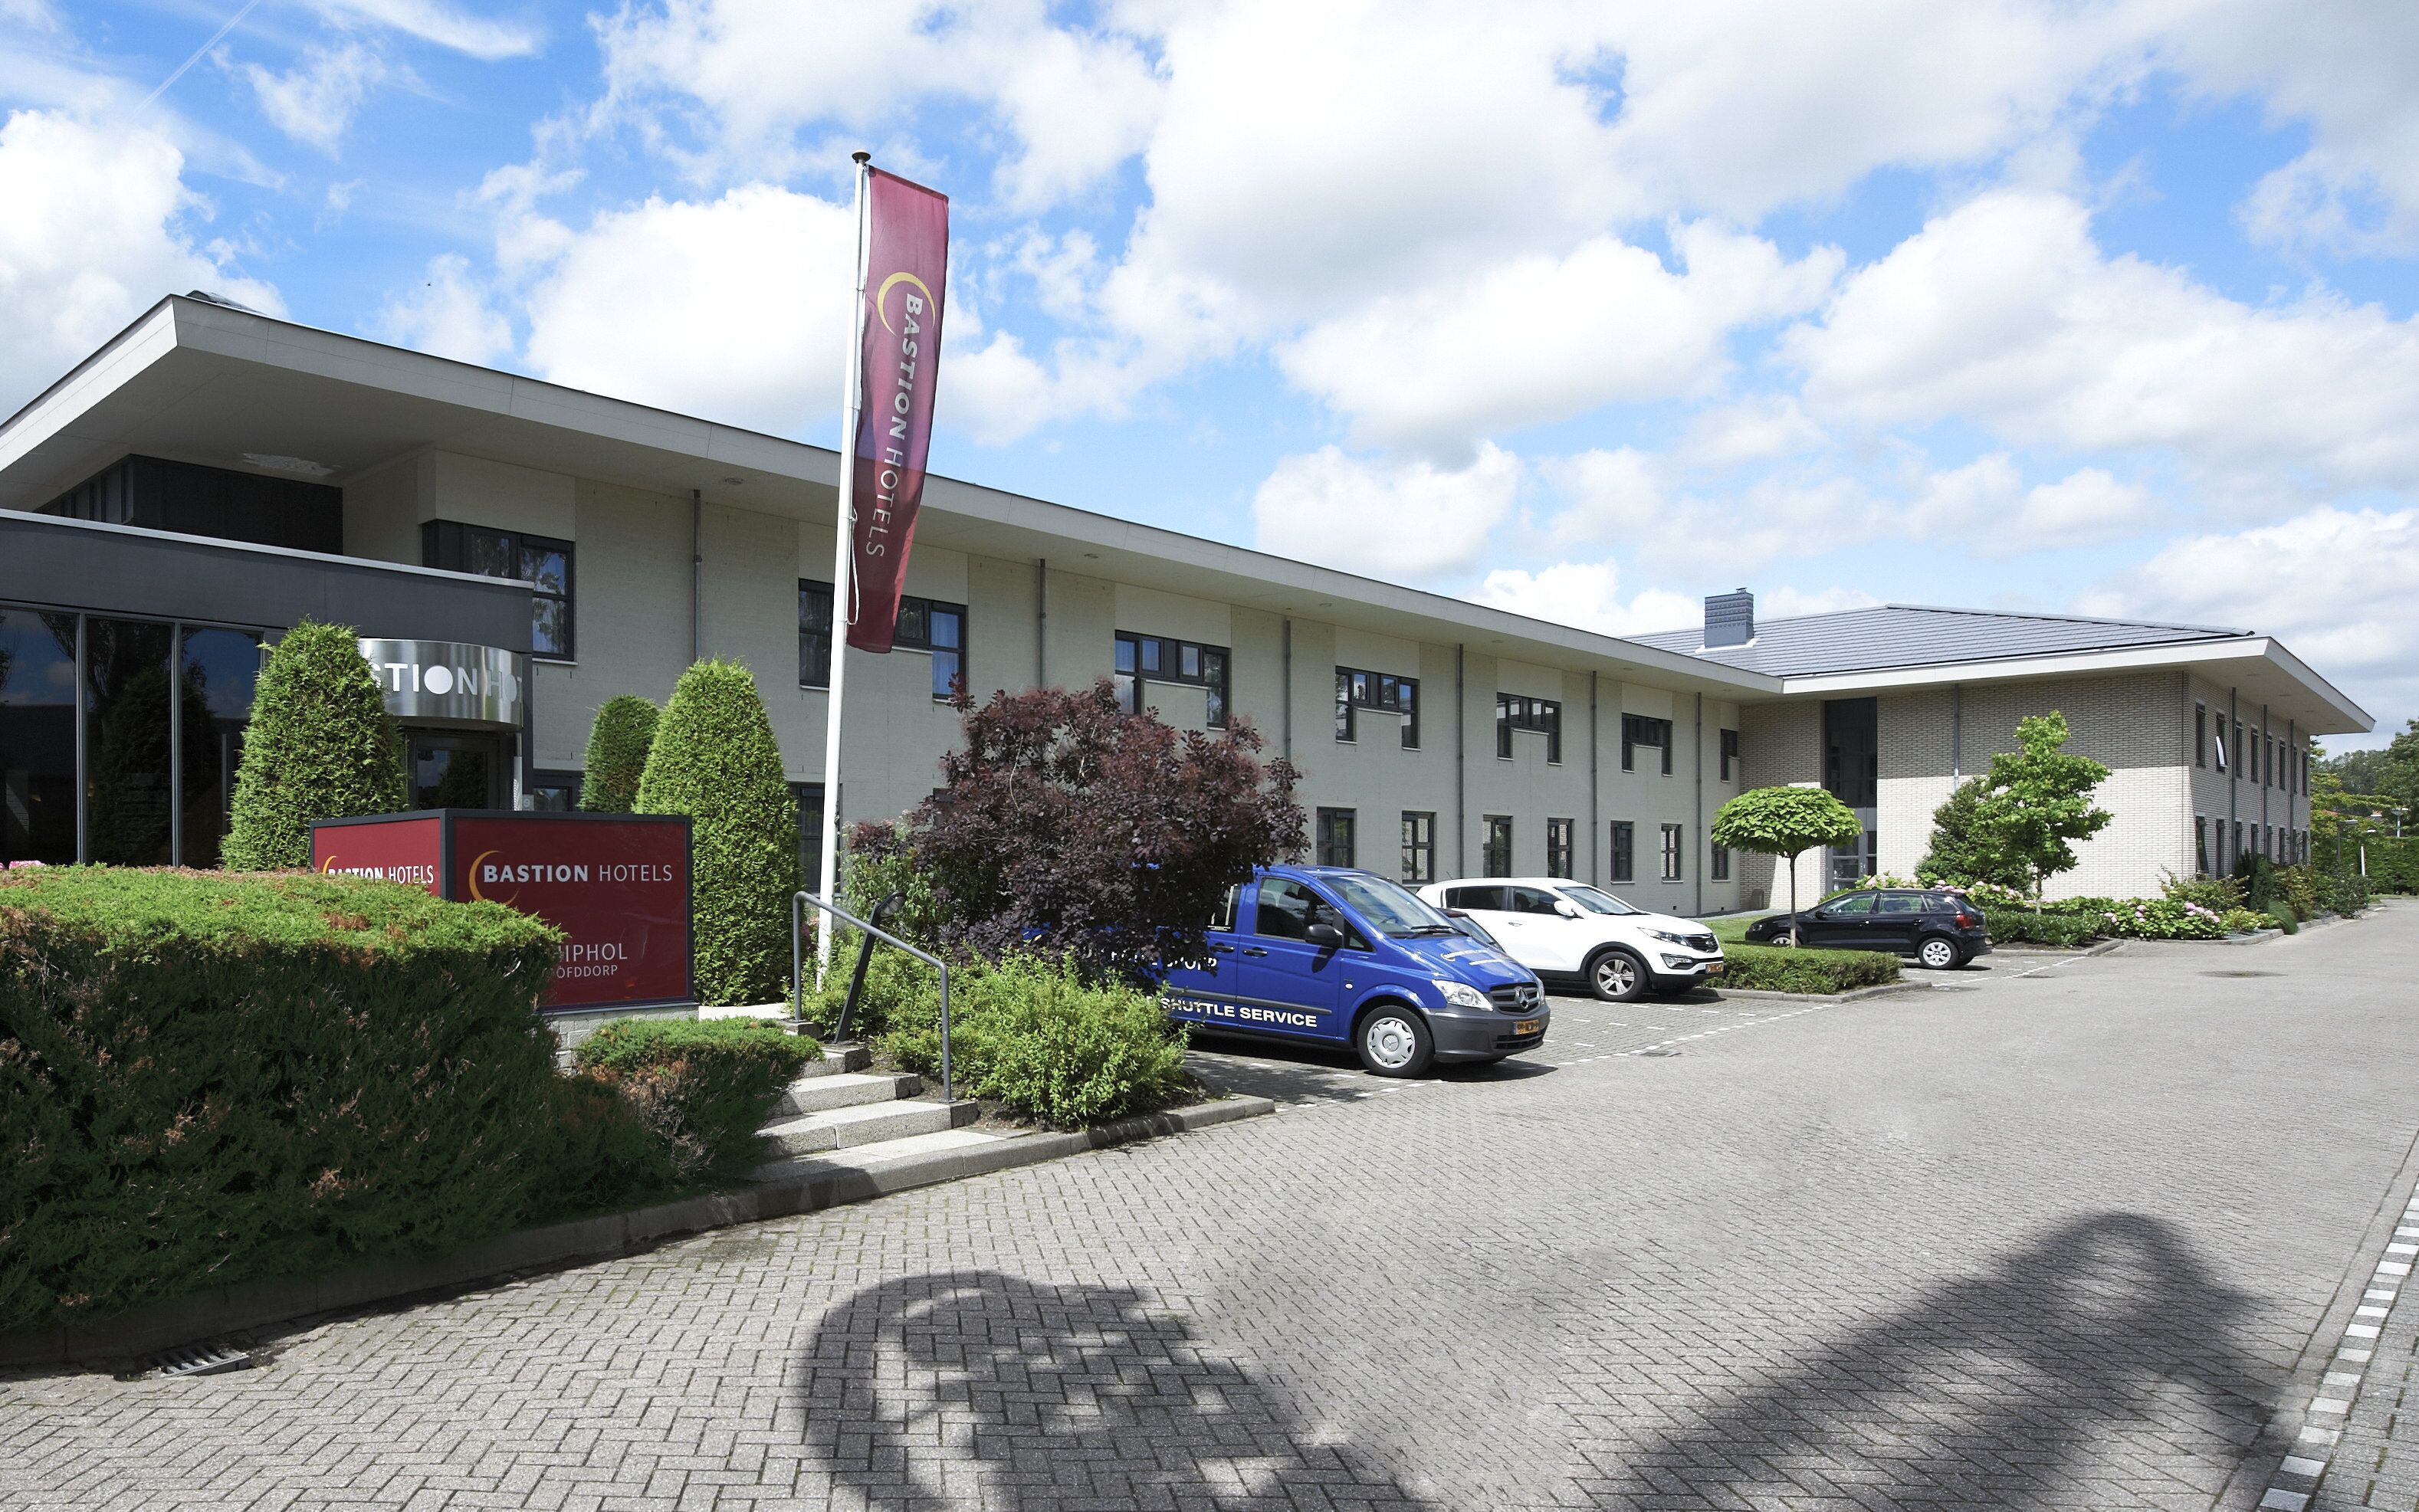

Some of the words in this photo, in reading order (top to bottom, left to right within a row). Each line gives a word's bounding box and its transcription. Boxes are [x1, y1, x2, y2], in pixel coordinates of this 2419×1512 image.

[891, 293, 923, 441] BASTION
[866, 447, 903, 557] HOTELS
[388, 864, 434, 884] HOTELS
[484, 864, 588, 883] BASTION
[599, 864, 672, 882] HOTELS
[558, 943, 628, 963] IPHOL
[1160, 997, 1236, 1018] SHUTTLE
[1239, 1006, 1318, 1028] SERVICE
